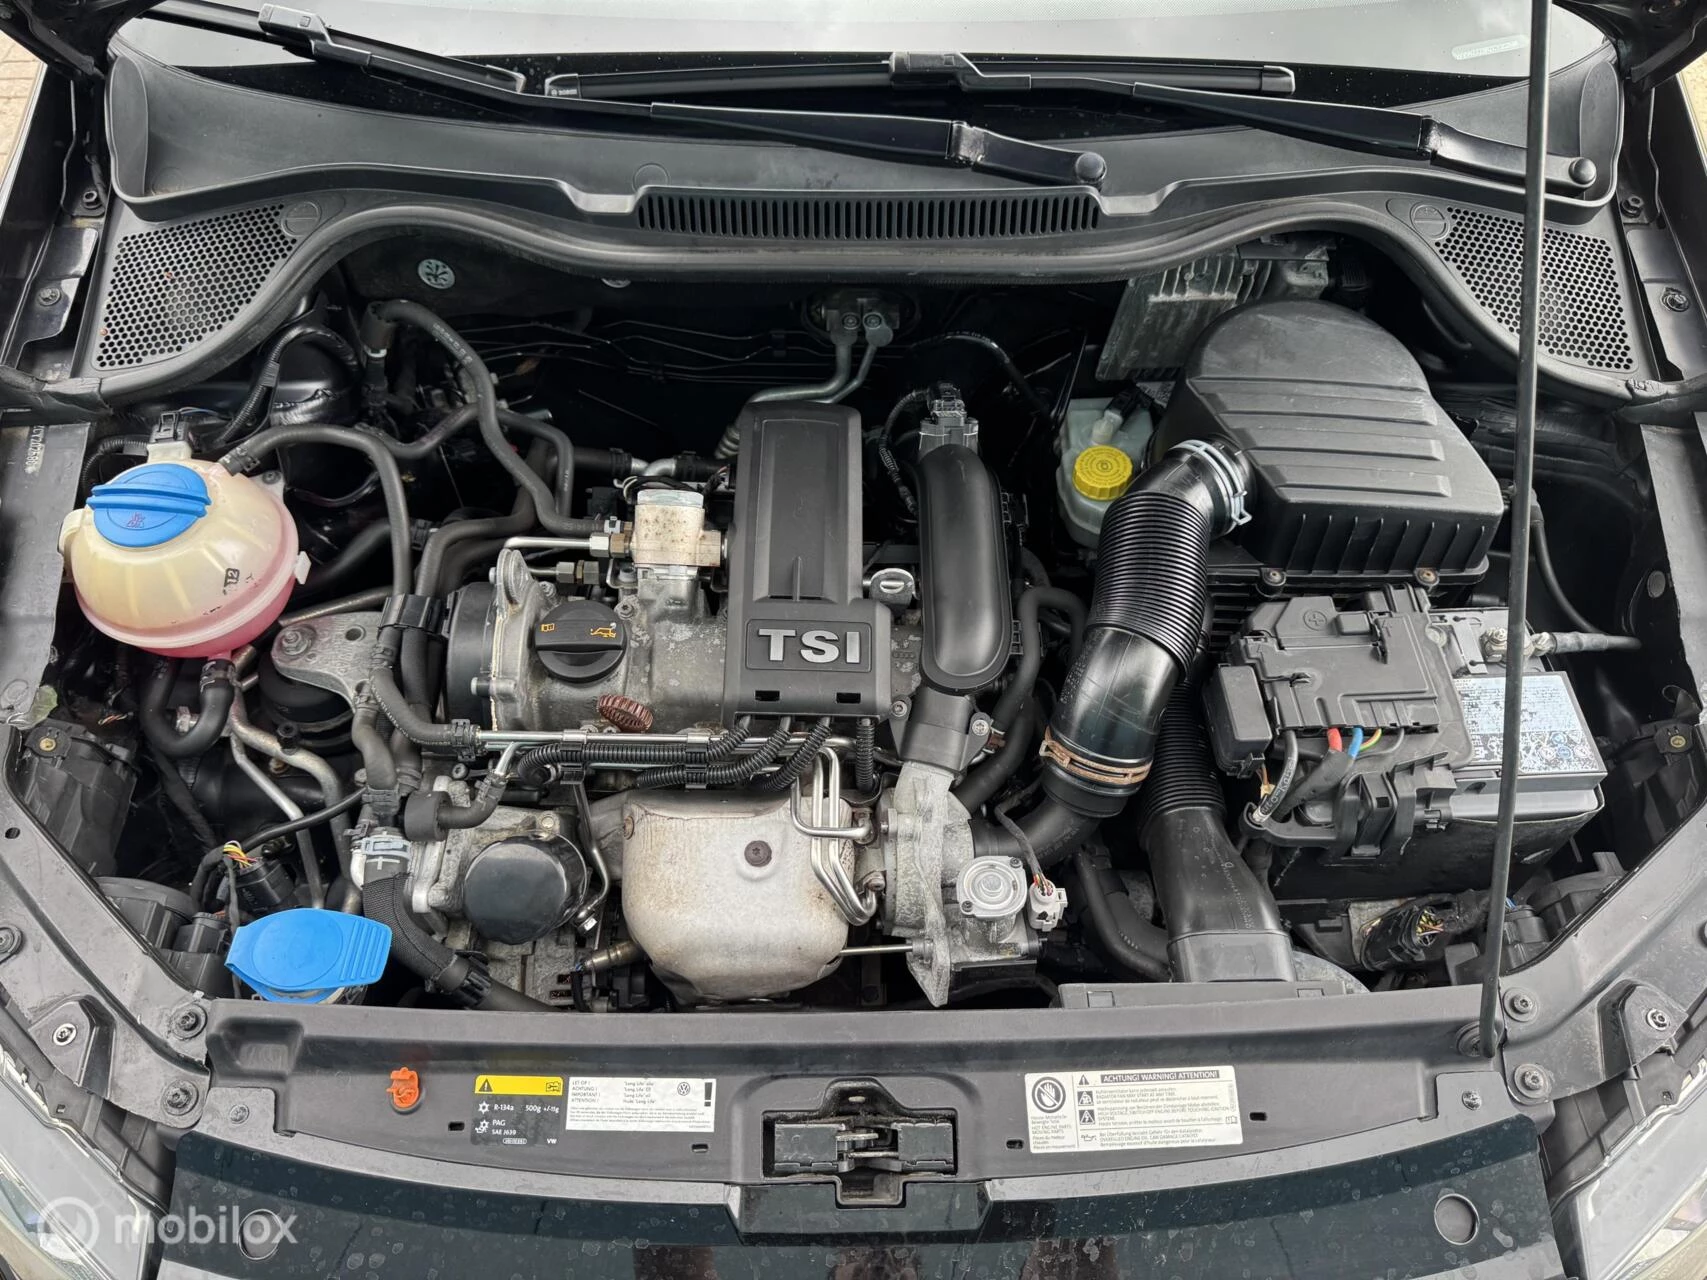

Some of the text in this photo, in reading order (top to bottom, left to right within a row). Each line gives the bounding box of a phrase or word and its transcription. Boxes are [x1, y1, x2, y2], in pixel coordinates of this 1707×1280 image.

[759, 628, 860, 663] TSI
[1103, 1070, 1218, 1082] ACHTUNG! WARNING! ATTENTION!
[525, 1105, 541, 1113] 500g
